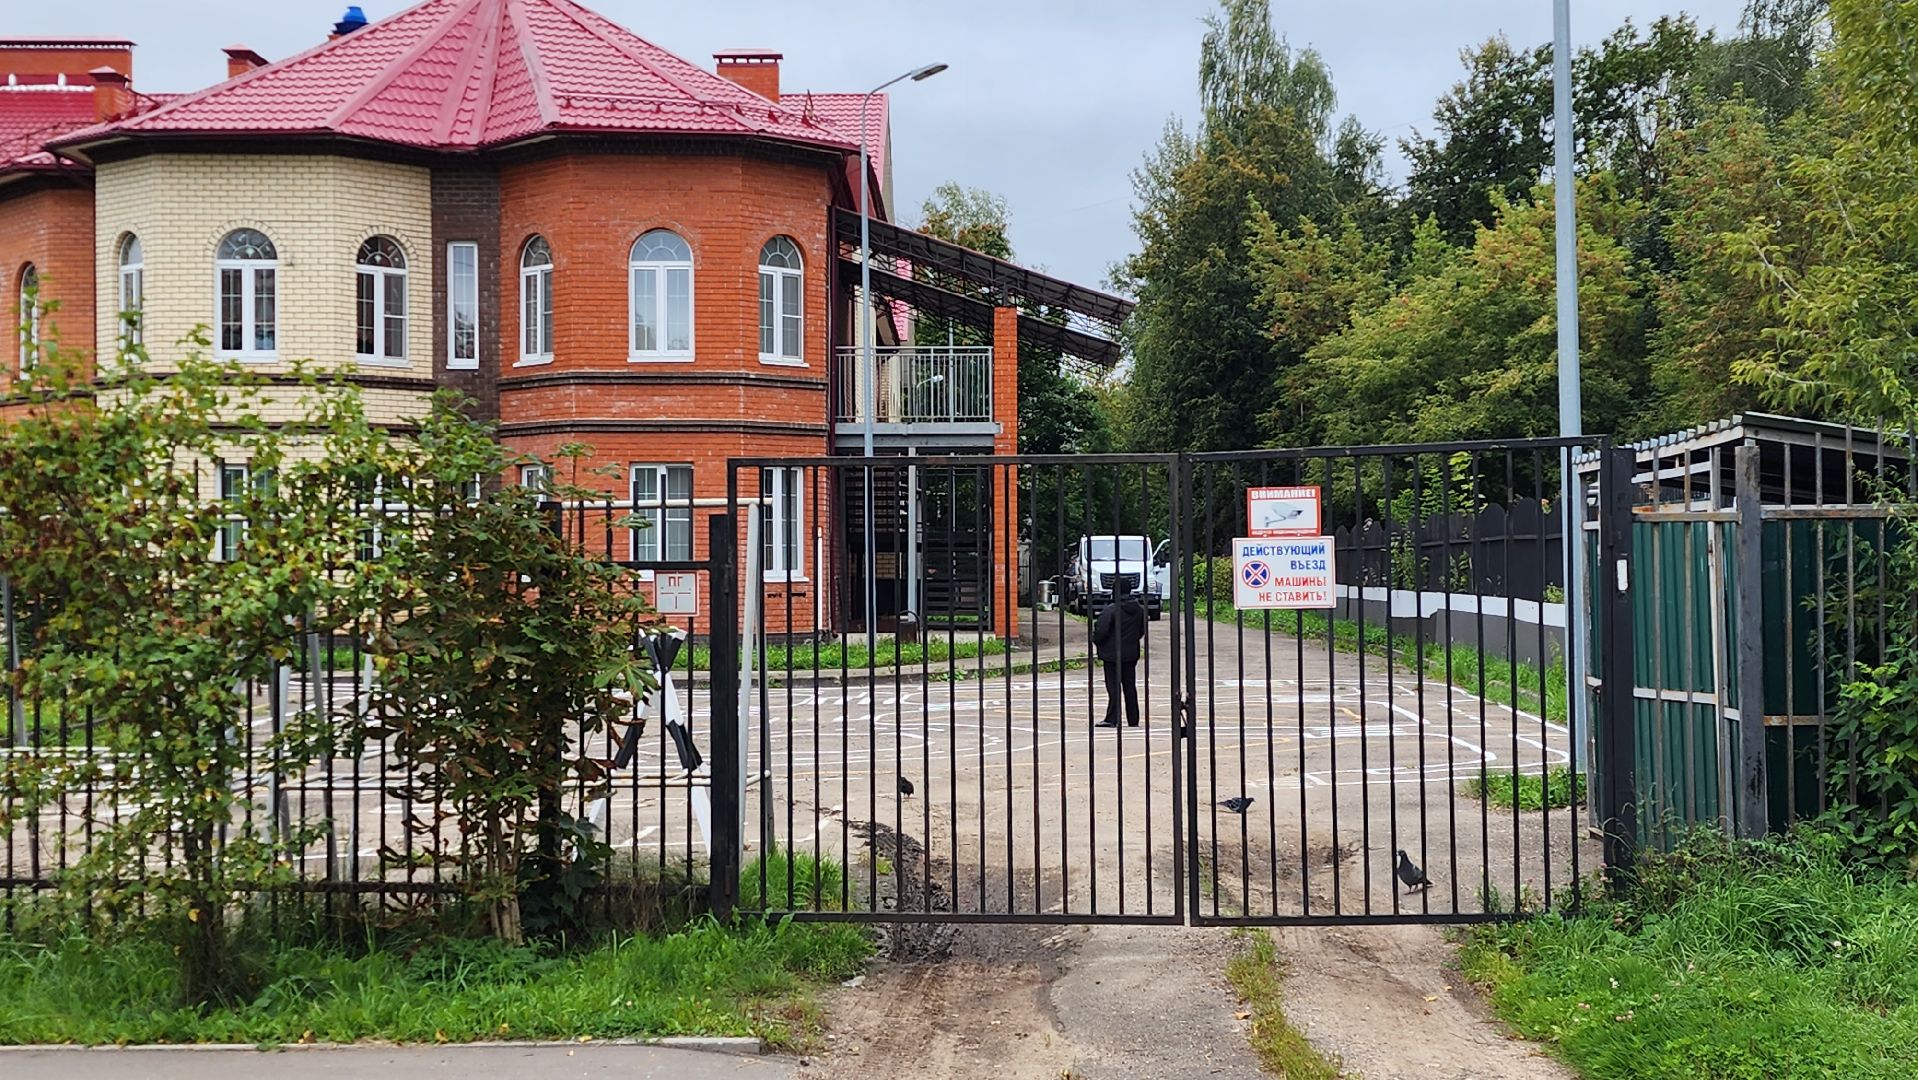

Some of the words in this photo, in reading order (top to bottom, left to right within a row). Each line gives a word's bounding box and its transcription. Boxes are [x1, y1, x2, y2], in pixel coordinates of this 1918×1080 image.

[1251, 488, 1316, 498] ВНИМАНИЕ!
[1242, 543, 1325, 556] ДЕЙСТВУЮЩИЙ
[1290, 560, 1326, 570] ВЪЕЗД
[668, 576, 683, 587] ПГ
[1258, 592, 1272, 602] НЕ
[1275, 591, 1327, 602] СТАВИТЬ!
